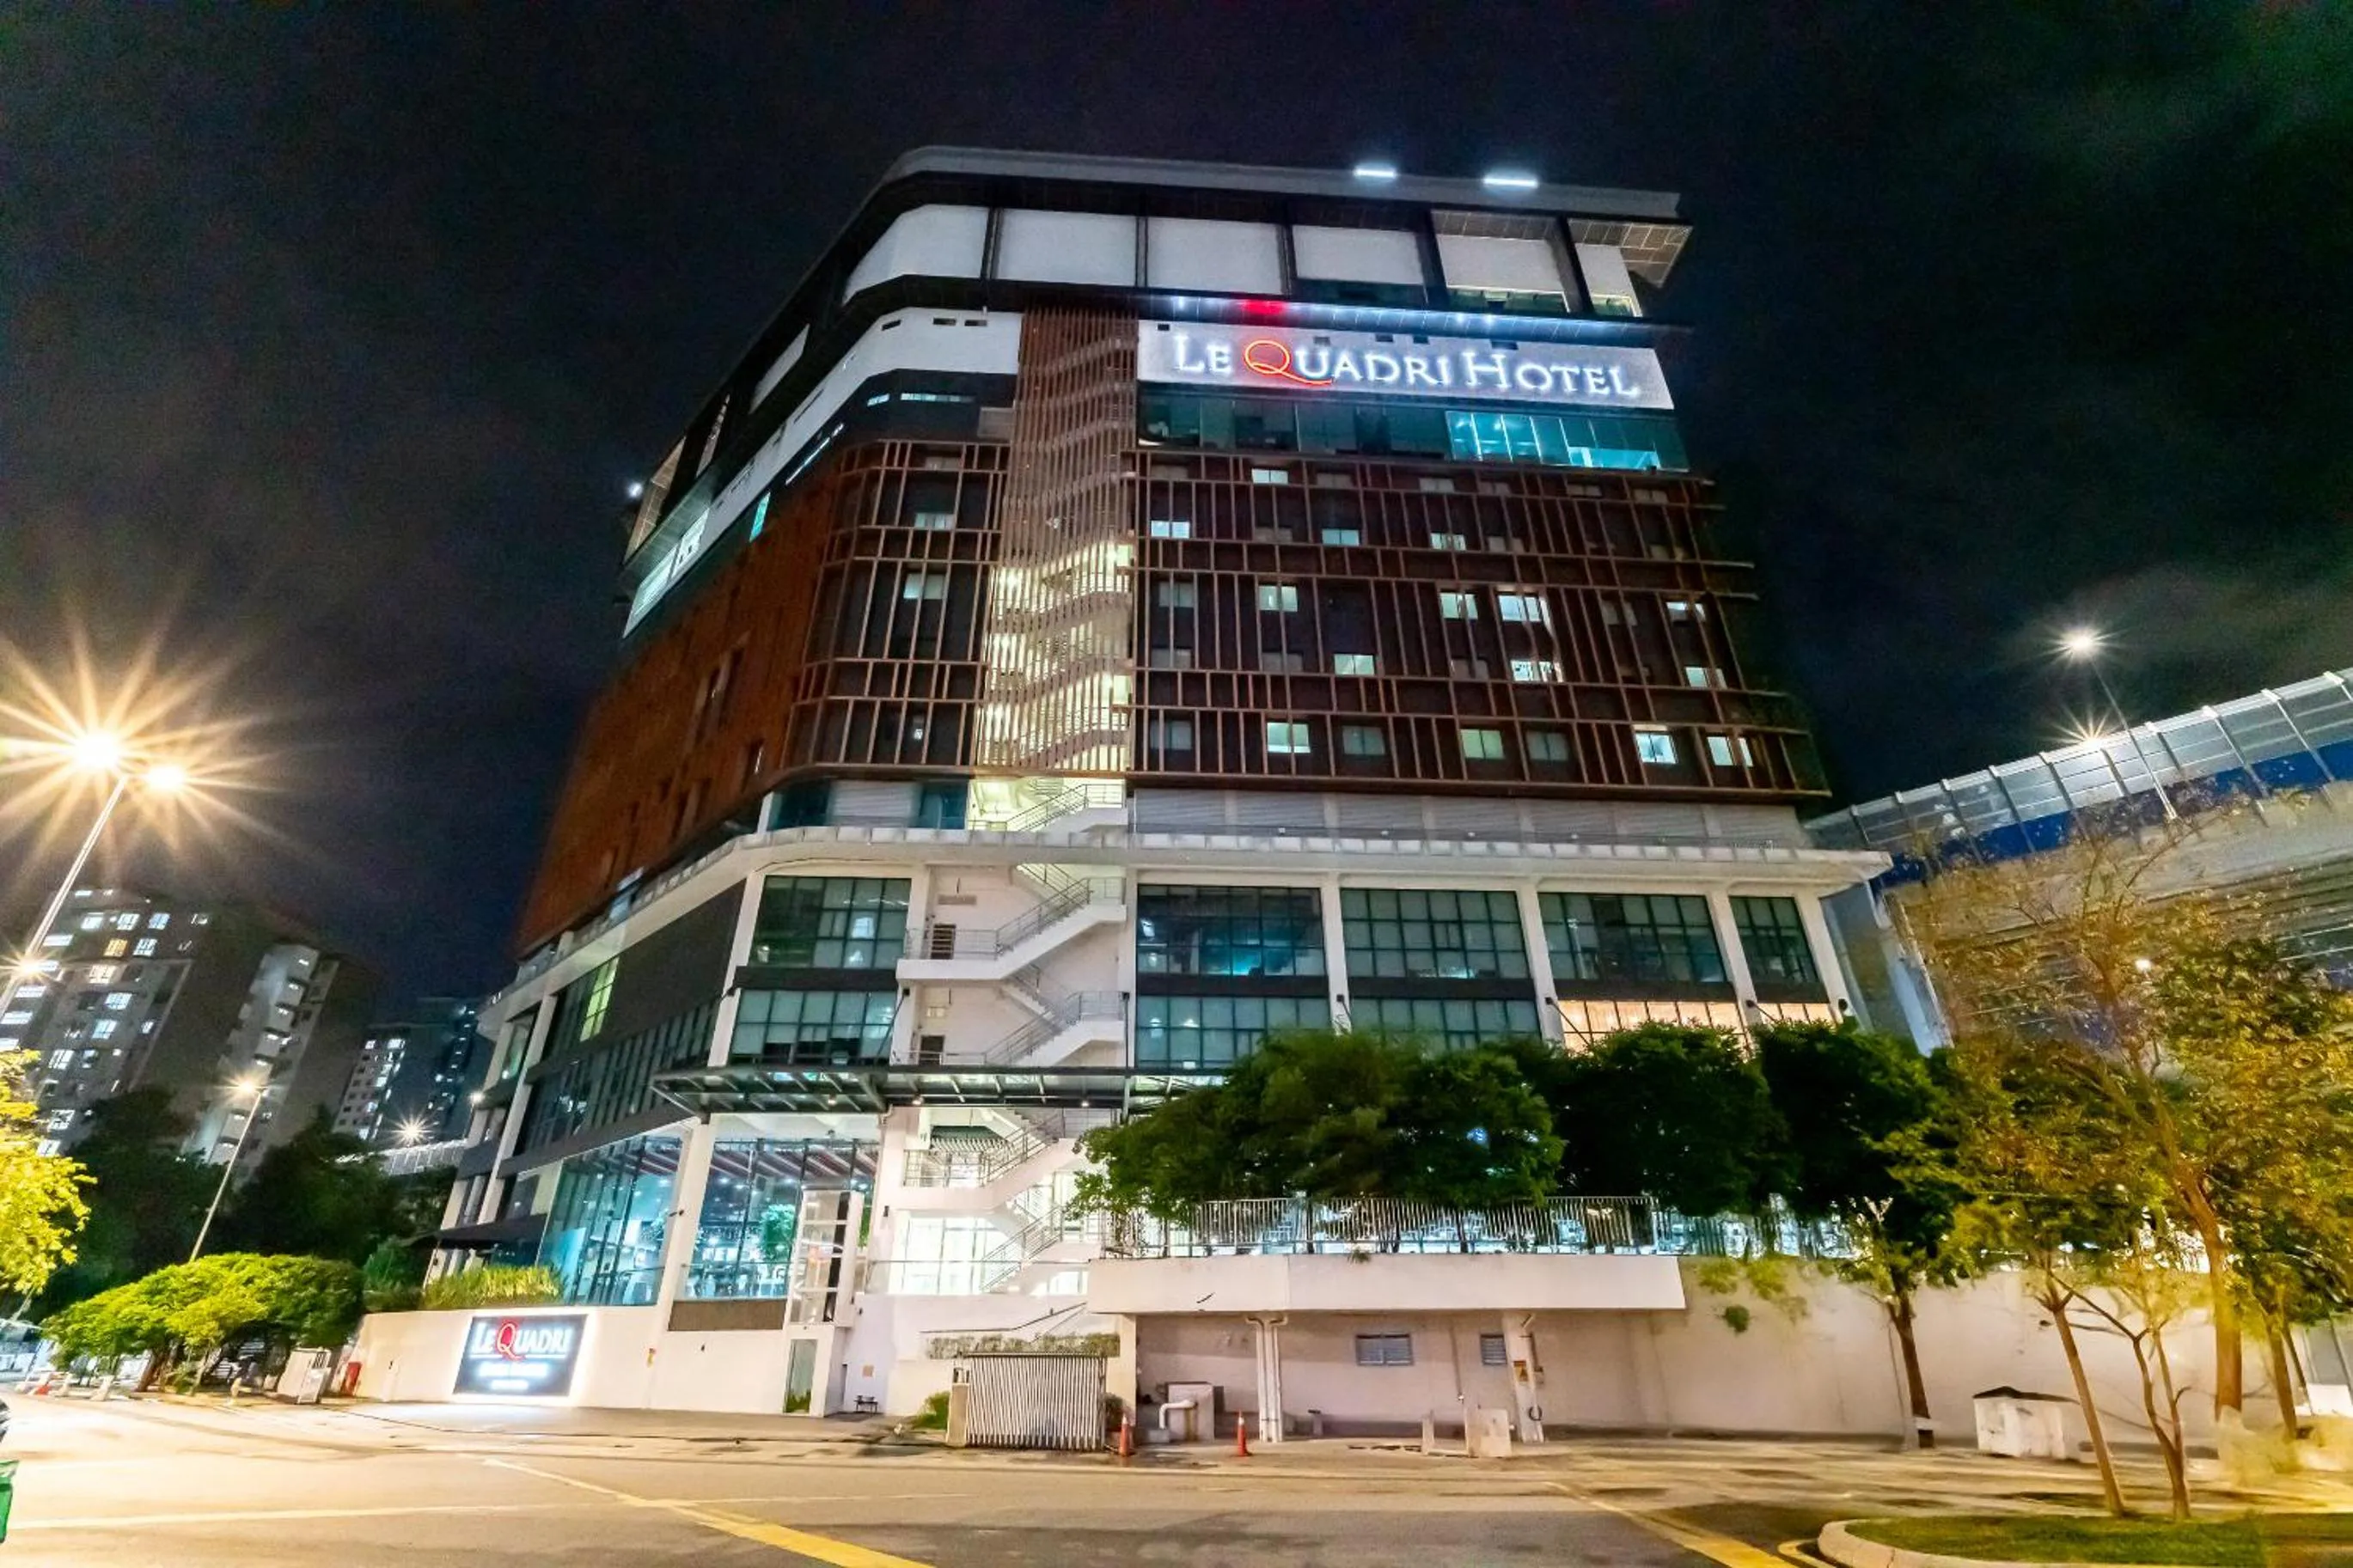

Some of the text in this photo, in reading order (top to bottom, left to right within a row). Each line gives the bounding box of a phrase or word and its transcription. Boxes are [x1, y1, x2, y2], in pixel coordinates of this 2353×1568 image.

[1175, 333, 1639, 397] LE QUADRI HOTEL
[471, 1322, 573, 1361] LE QUADRI
